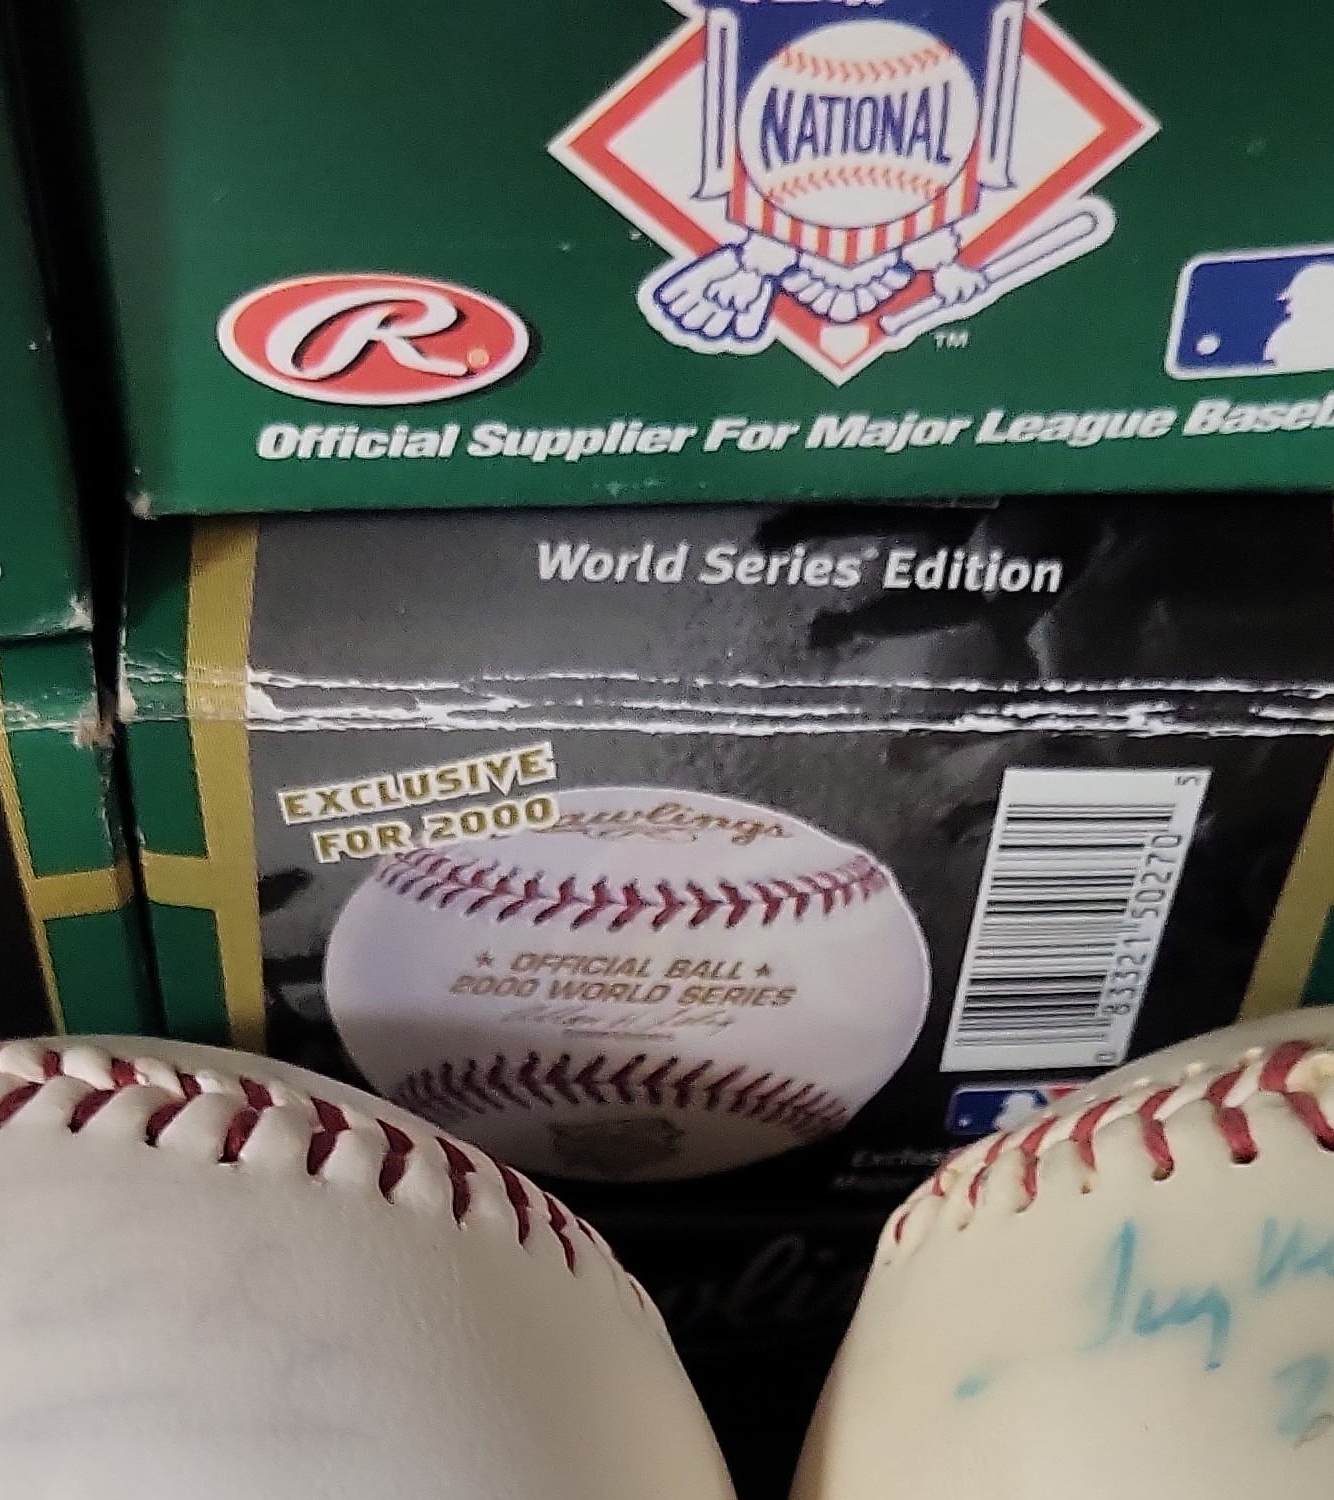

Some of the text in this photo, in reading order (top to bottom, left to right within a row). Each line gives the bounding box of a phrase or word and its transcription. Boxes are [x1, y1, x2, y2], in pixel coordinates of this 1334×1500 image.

[758, 79, 953, 168] NATIONAL
[258, 420, 460, 461] Official
[467, 417, 696, 463] Supplier
[703, 418, 798, 452] For
[805, 413, 970, 454] Major
[976, 405, 1175, 447] League
[538, 542, 1064, 593] World Series Edition
[283, 748, 549, 818] EXCLUSIVE
[317, 796, 553, 861] FOR 2000
[1102, 938, 1152, 1015] 83321
[1131, 834, 1182, 918] 50270
[449, 975, 797, 1007] 2000 WORLD SERIES
[511, 953, 745, 981] OFFICIAL BALL
